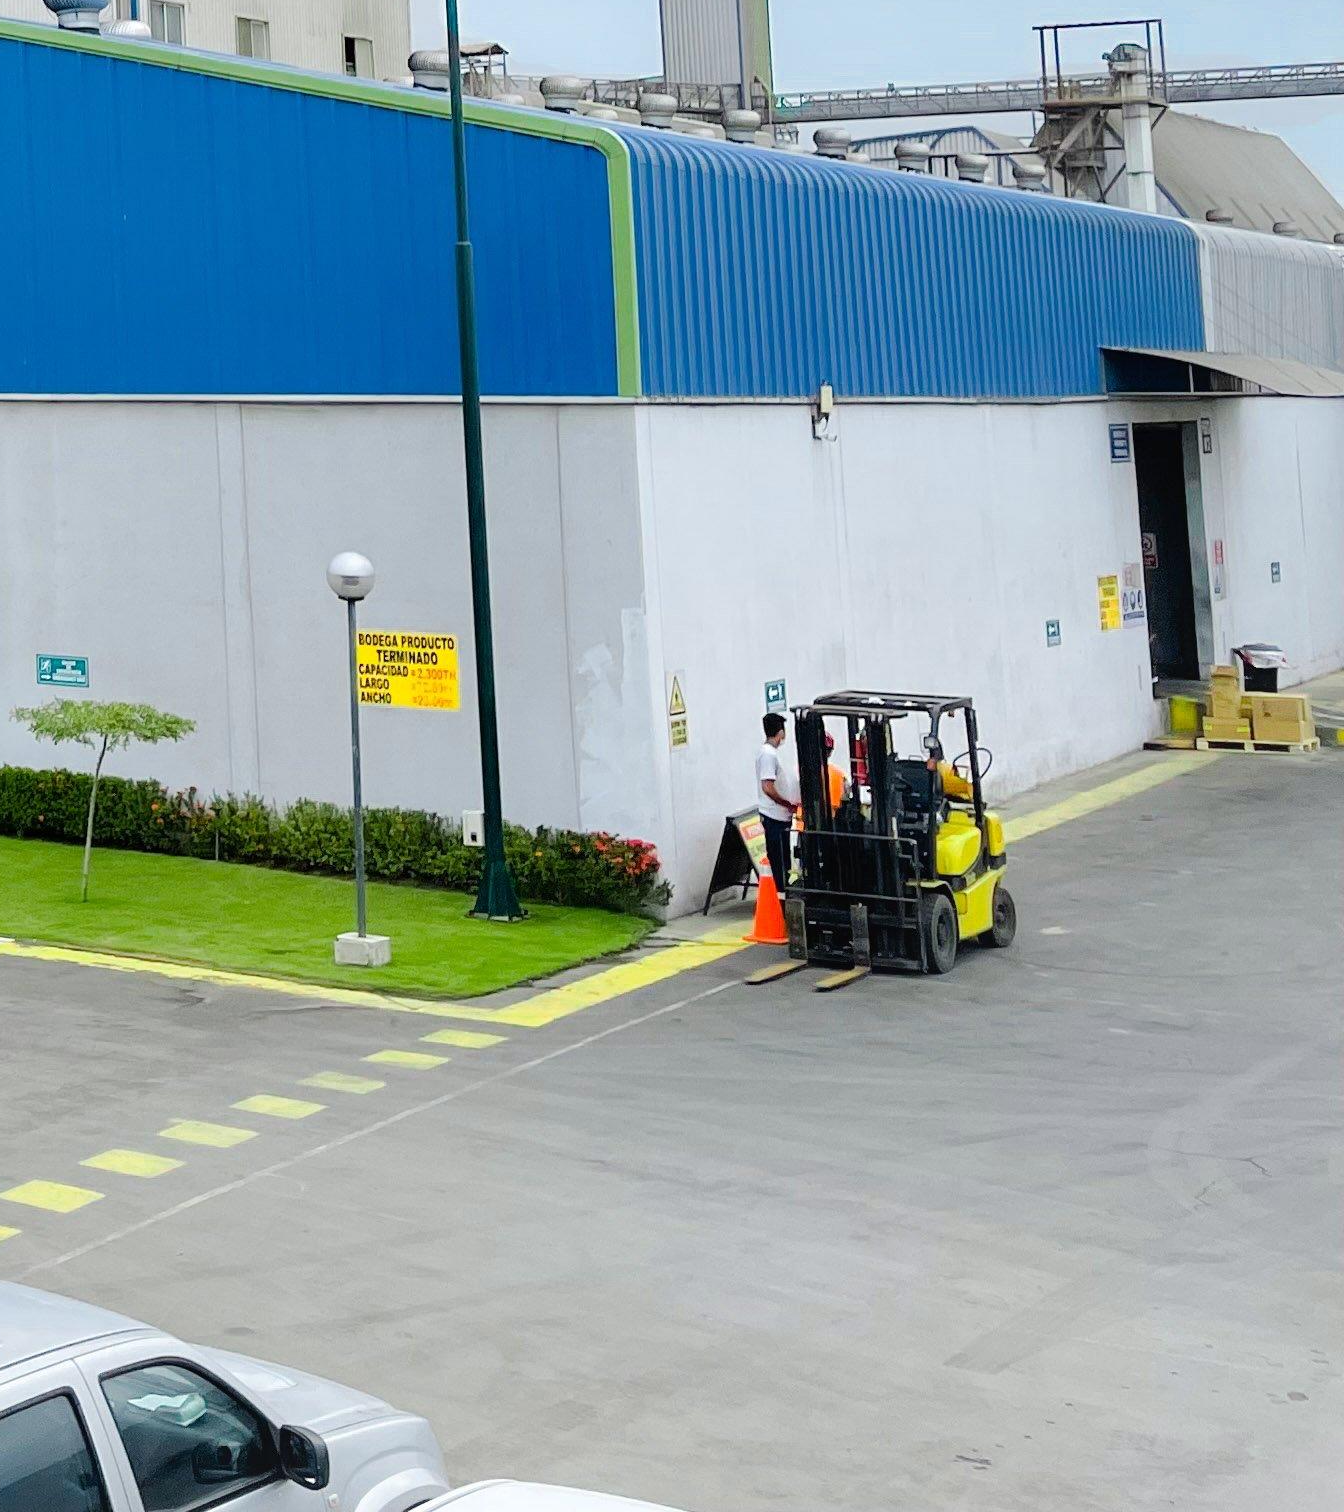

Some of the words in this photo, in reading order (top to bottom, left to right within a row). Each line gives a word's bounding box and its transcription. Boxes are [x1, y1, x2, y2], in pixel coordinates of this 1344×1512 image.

[358, 633, 398, 647] BODEGA
[401, 635, 455, 650] PRODUCTO
[376, 650, 438, 665] TERMINADO
[358, 664, 409, 677] CAPACIDAD
[359, 678, 390, 690] LARGO
[360, 692, 392, 704] ANCHO
